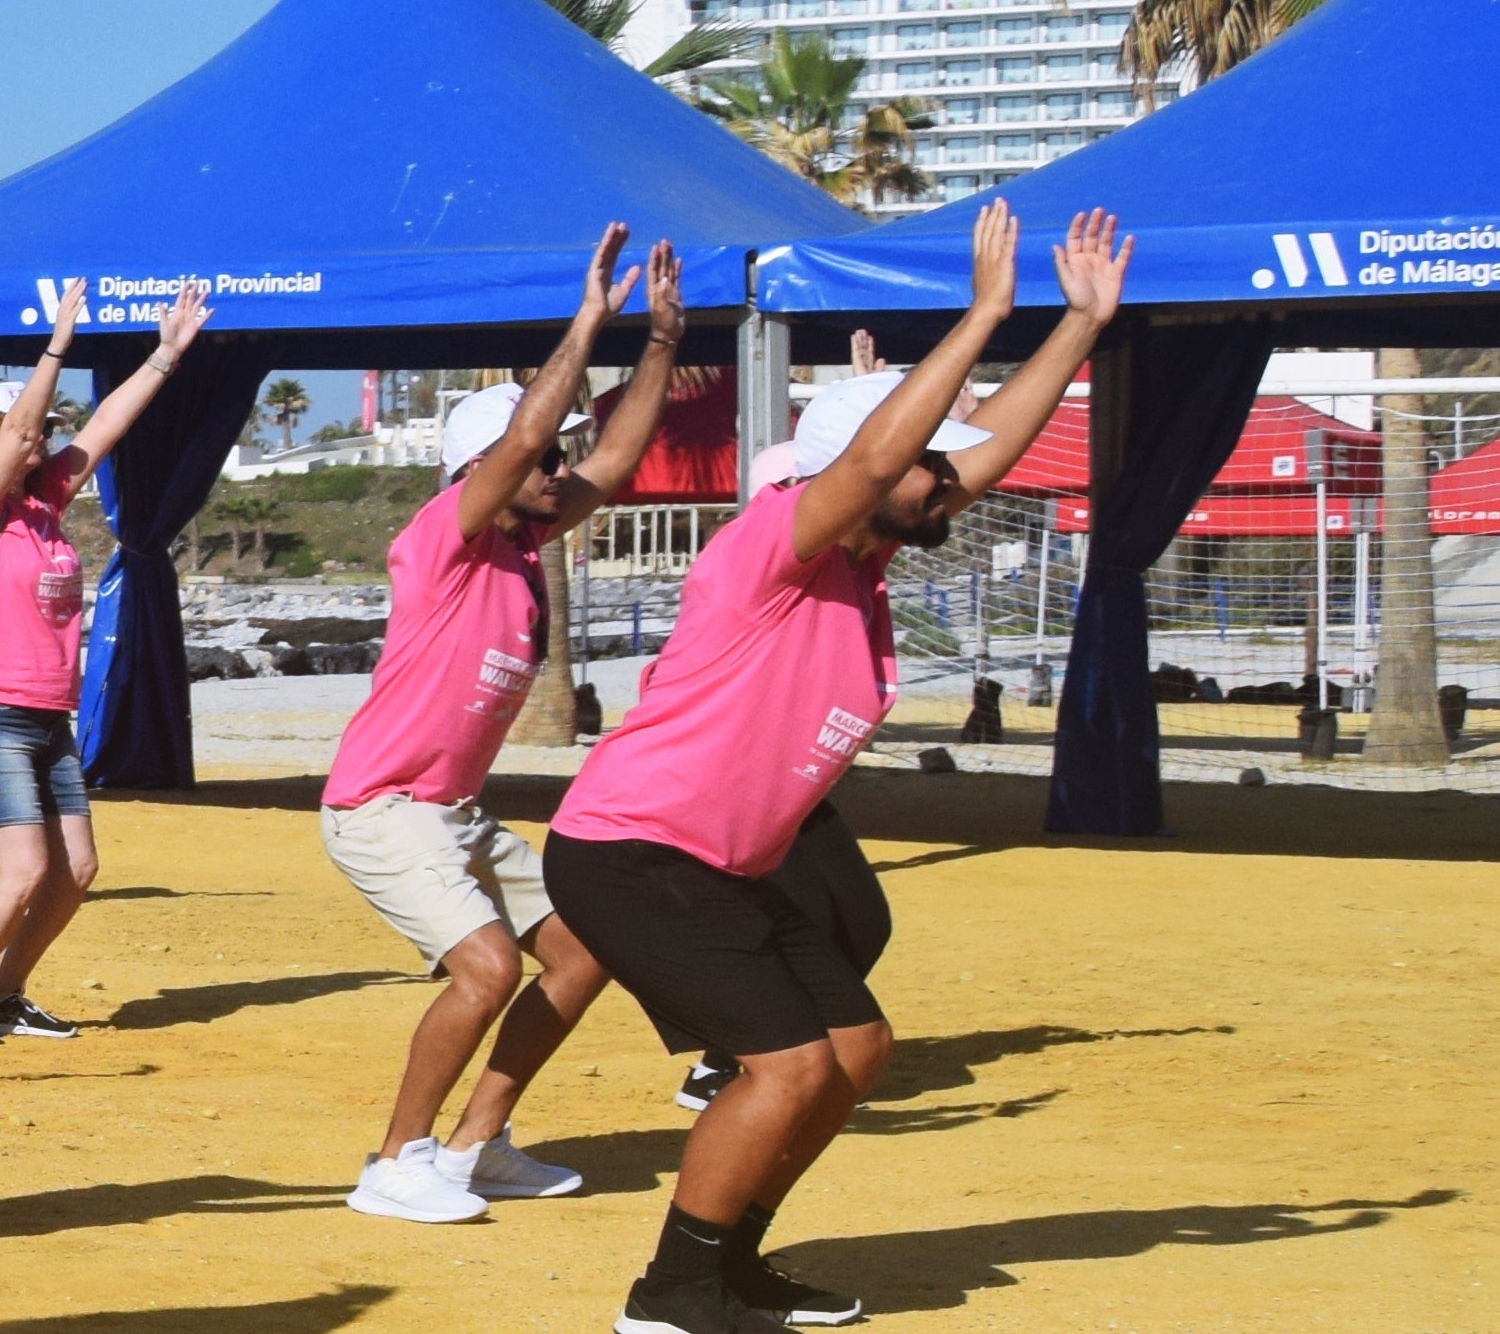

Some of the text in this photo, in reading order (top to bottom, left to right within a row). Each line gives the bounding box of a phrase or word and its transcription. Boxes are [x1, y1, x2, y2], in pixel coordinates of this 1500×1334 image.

[216, 272, 322, 294] Provincial
[1358, 258, 1500, 287] de Málaga
[98, 304, 125, 323] de
